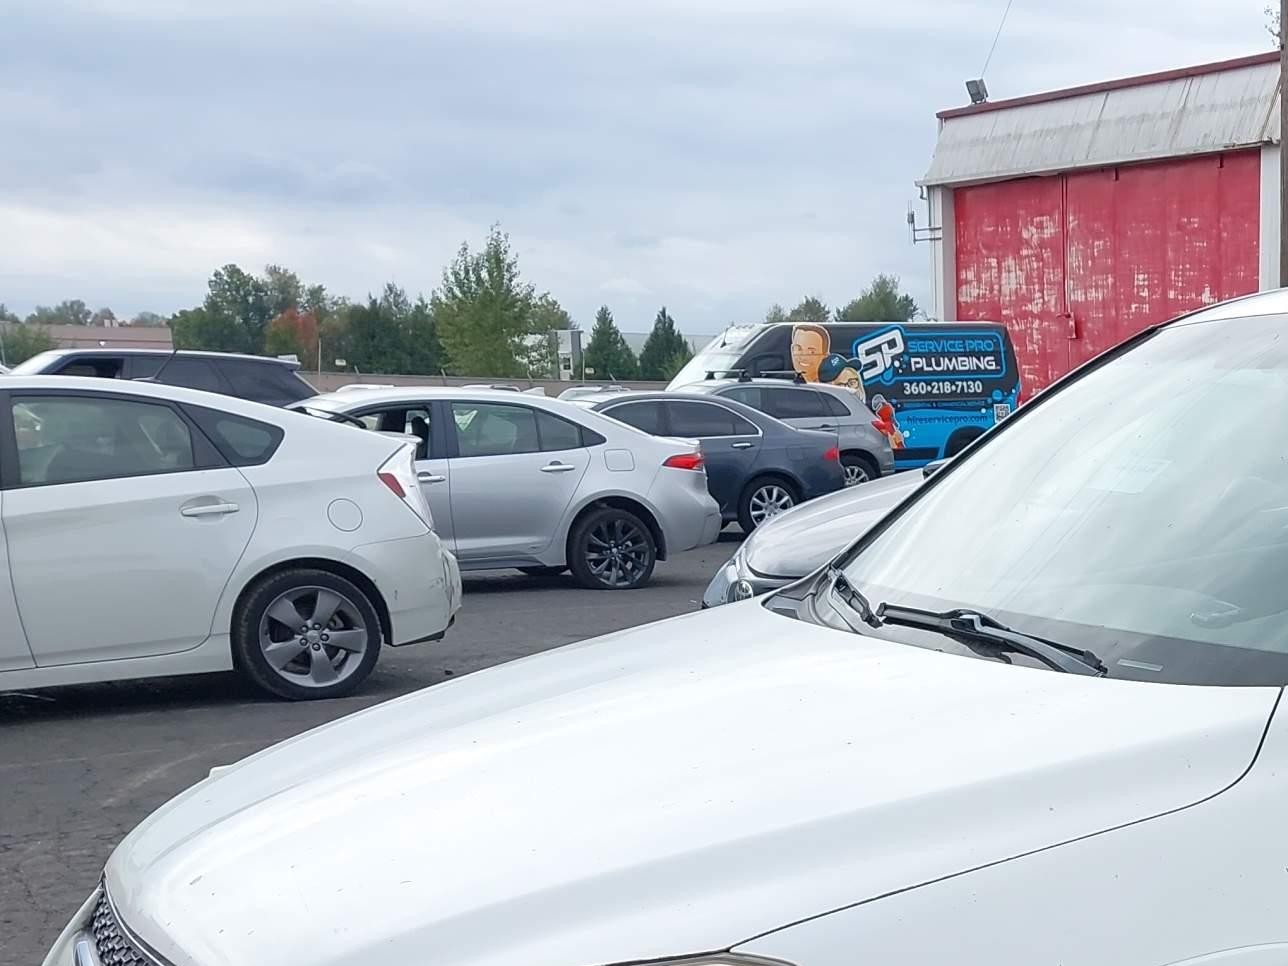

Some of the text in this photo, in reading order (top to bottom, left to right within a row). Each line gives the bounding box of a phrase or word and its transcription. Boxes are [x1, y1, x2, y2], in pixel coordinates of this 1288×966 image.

[907, 340, 994, 352] SERVICE PRO
[857, 329, 904, 380] SP
[910, 356, 996, 372] PLUMBING
[906, 415, 987, 424] hireservicepro.com
